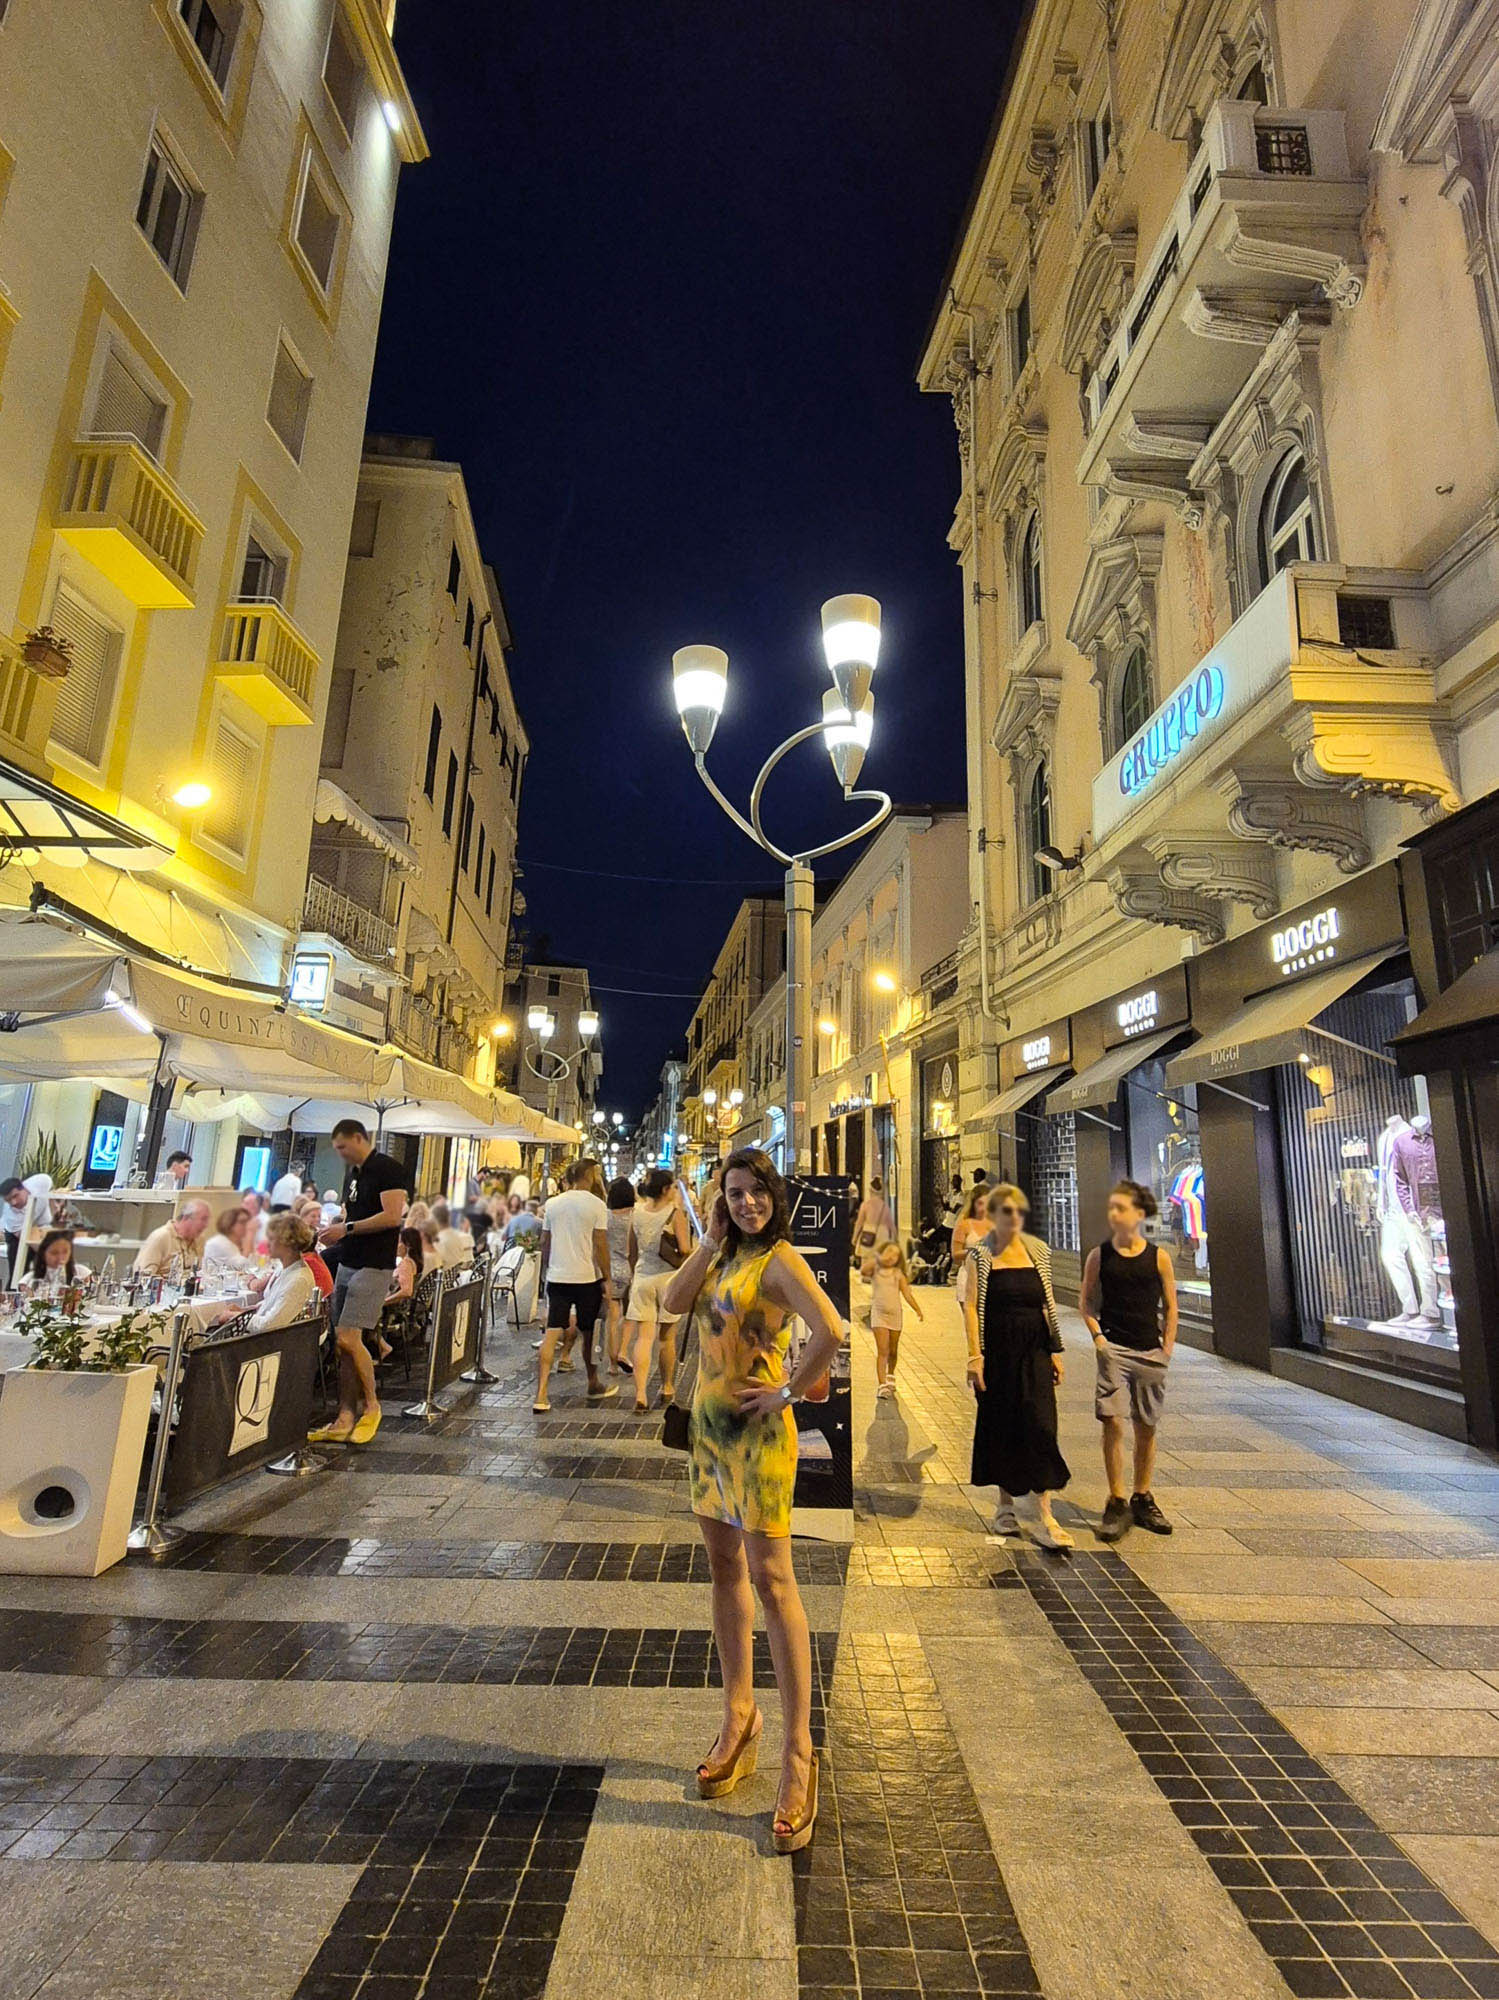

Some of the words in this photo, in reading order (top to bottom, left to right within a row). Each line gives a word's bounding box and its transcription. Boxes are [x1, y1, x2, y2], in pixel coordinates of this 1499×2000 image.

[1119, 667, 1223, 796] GRUPPO
[1271, 907, 1339, 962] BOGGI
[1210, 1044, 1240, 1066] BOGGI
